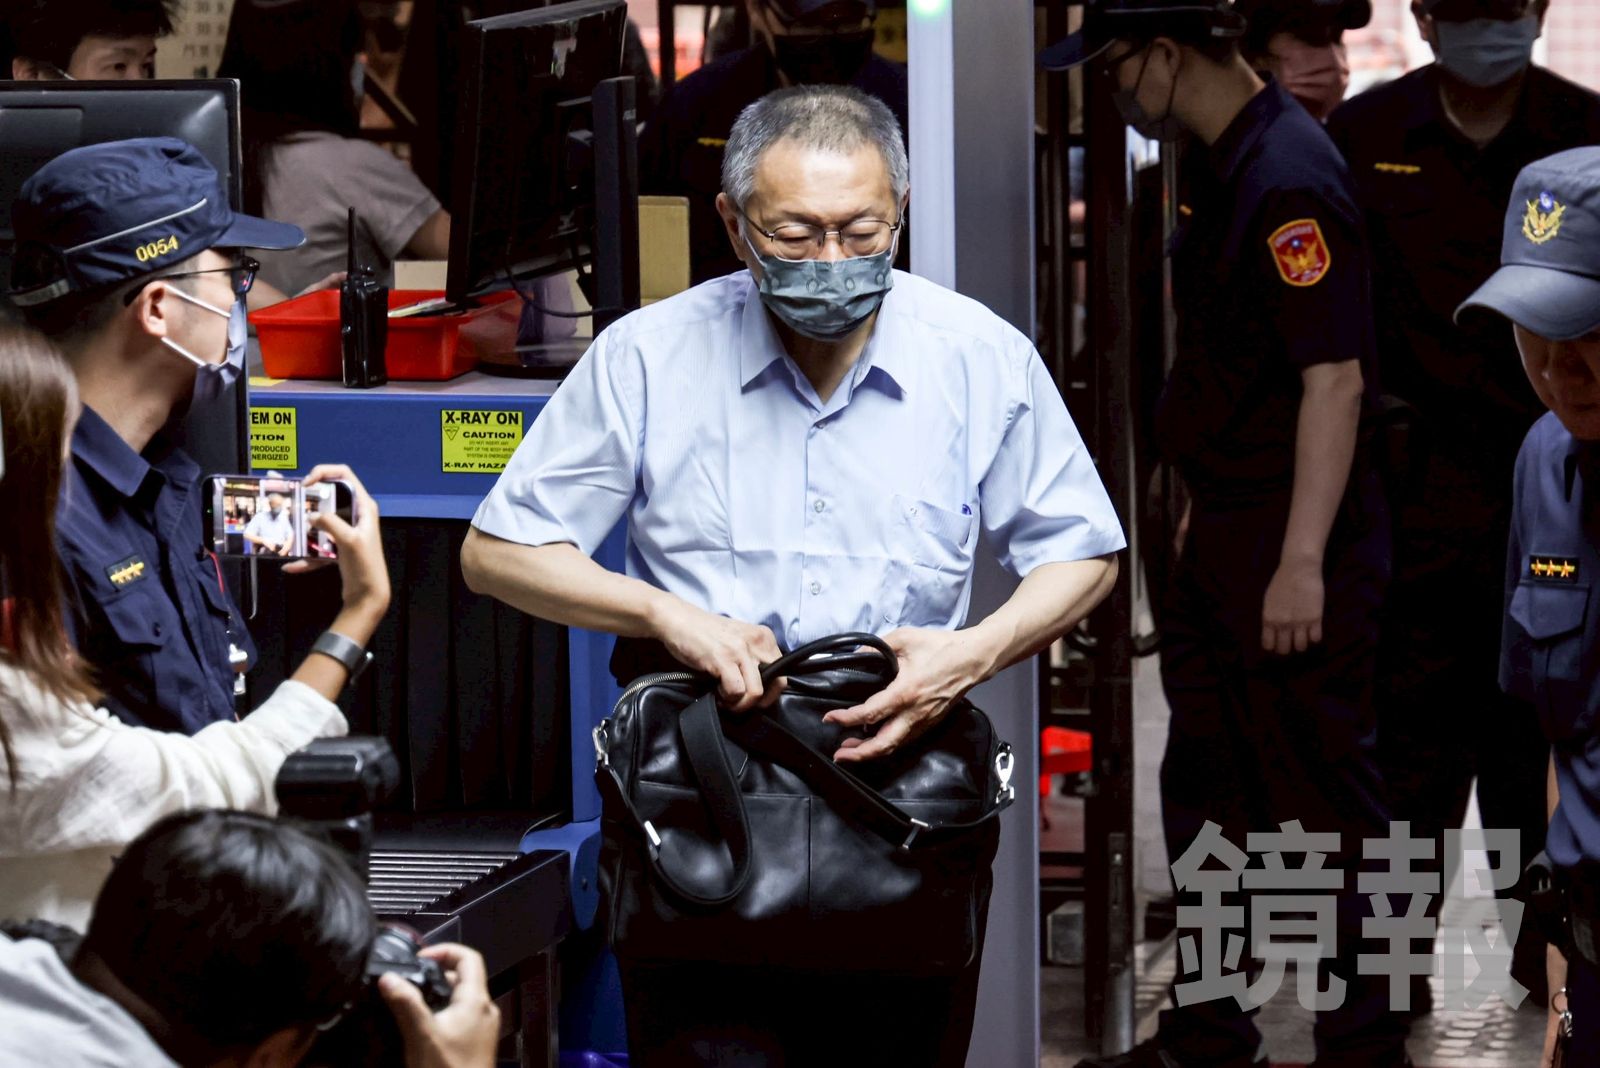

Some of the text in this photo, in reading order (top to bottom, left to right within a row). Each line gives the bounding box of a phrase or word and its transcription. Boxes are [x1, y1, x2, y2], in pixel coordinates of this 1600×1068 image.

[136, 235, 179, 261] 0054
[250, 412, 292, 424] EM ON
[445, 411, 519, 425] X-RAY ON
[463, 431, 515, 439] CAUTION
